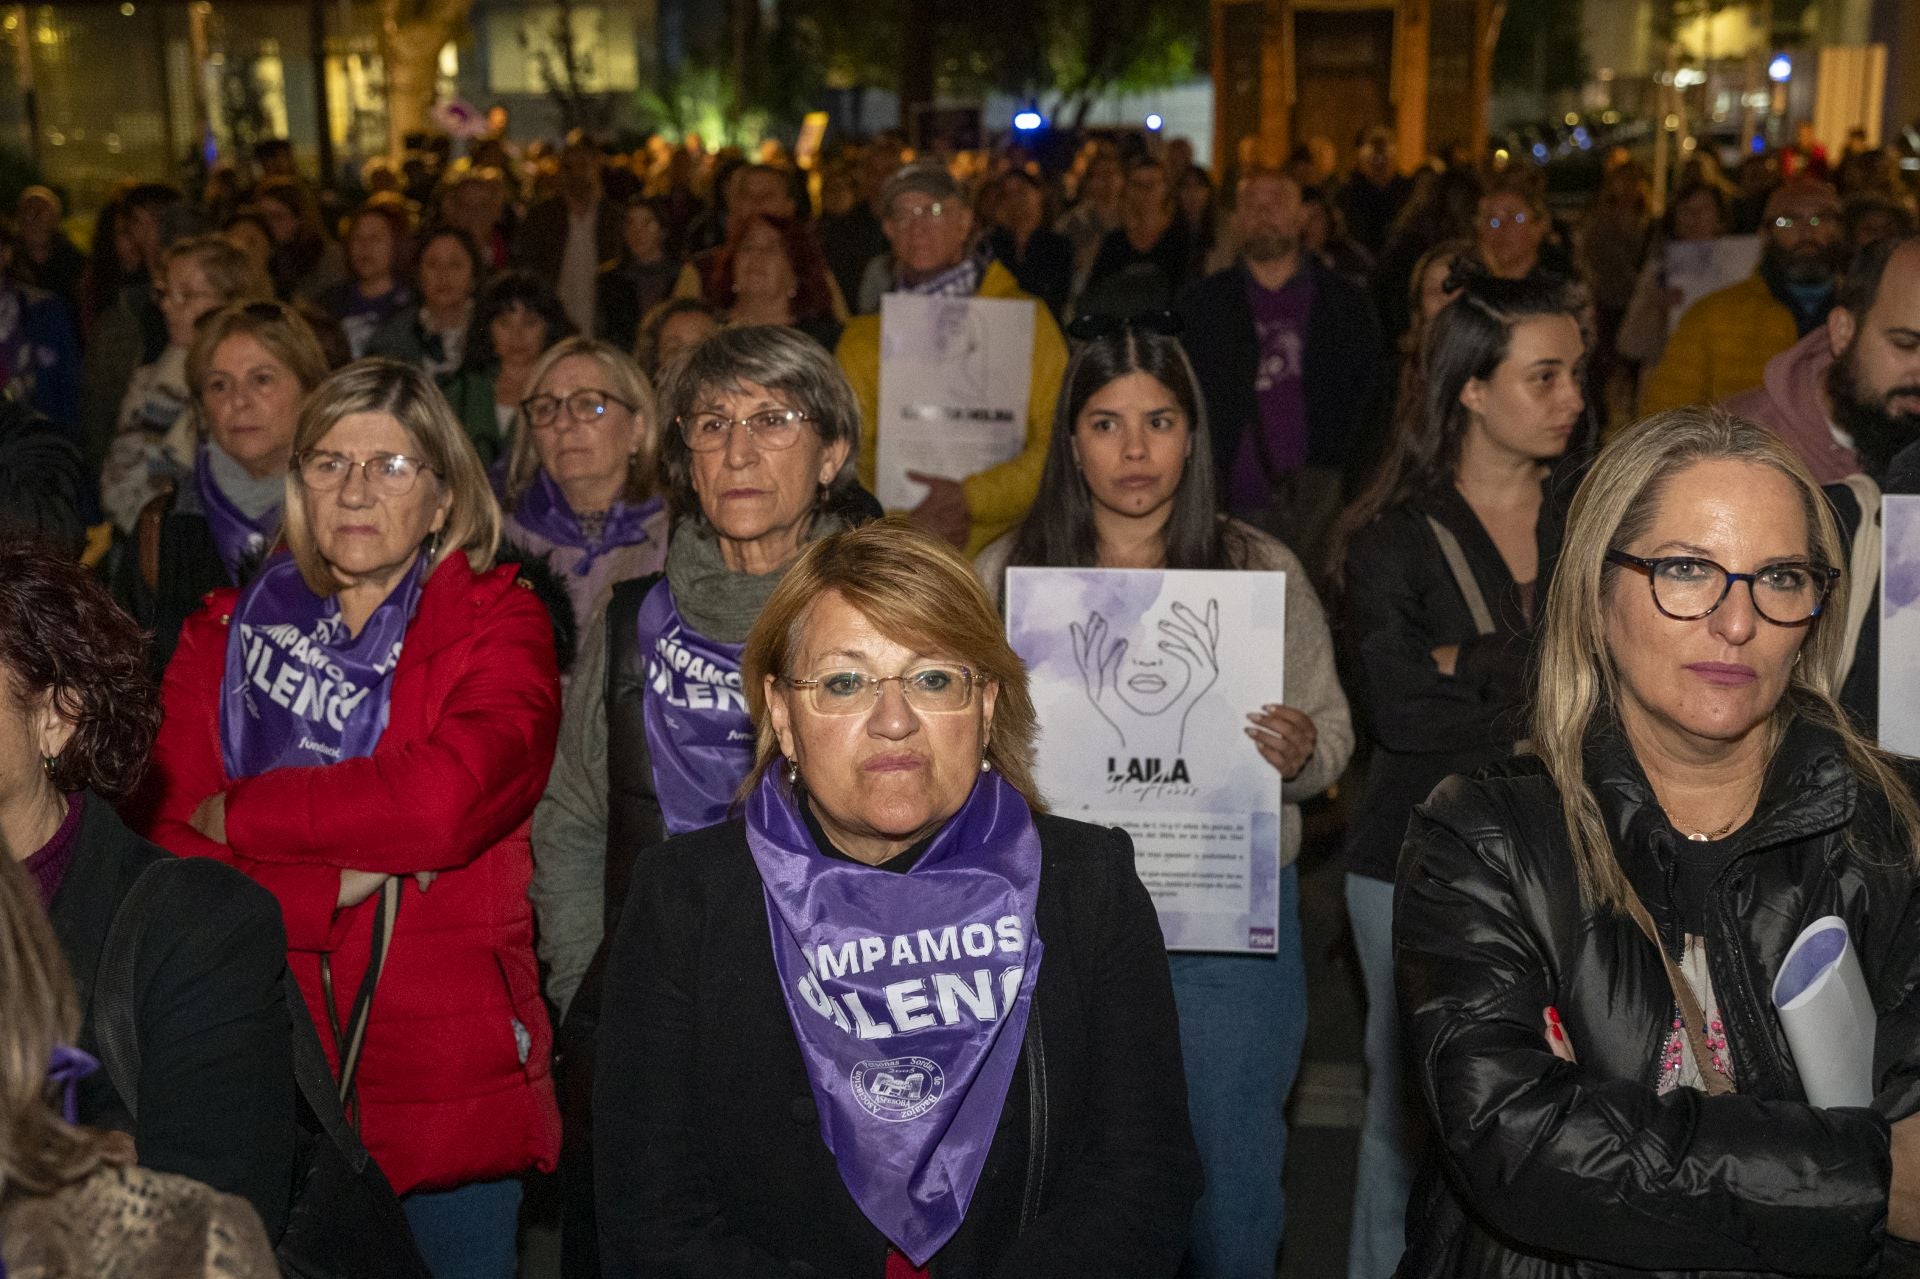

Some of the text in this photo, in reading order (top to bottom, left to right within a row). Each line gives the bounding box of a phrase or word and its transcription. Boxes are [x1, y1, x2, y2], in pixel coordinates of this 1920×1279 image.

[258, 622, 356, 696] MPAMOS
[656, 637, 742, 687] MPAMO
[1108, 756, 1190, 783] LAILA
[801, 914, 1024, 981] MPAMOS
[901, 1094, 937, 1118] Badajoz
